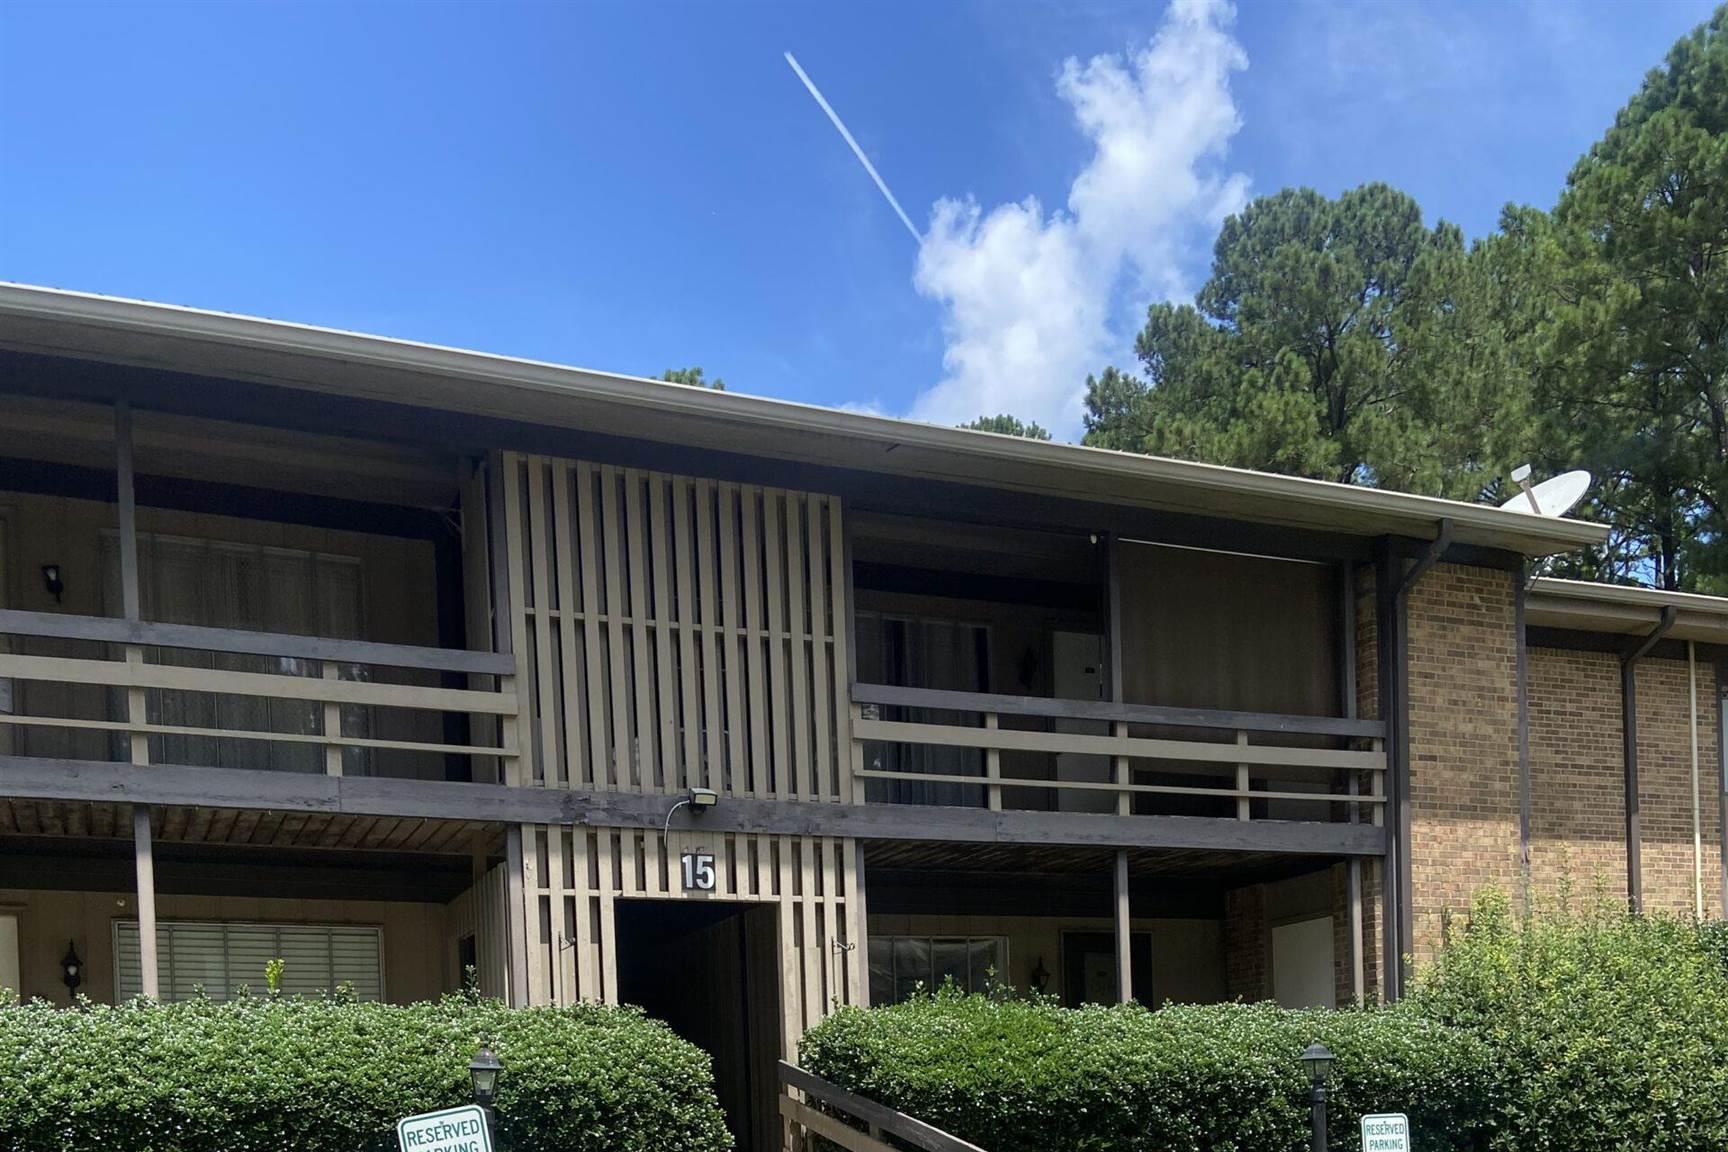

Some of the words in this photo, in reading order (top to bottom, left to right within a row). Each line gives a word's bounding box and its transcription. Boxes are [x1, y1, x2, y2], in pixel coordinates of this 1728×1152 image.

[682, 855, 715, 889] 15
[406, 1119, 480, 1147] RESERVED
[1366, 1123, 1404, 1135] RESERVED
[1369, 1139, 1403, 1150] PARKING
